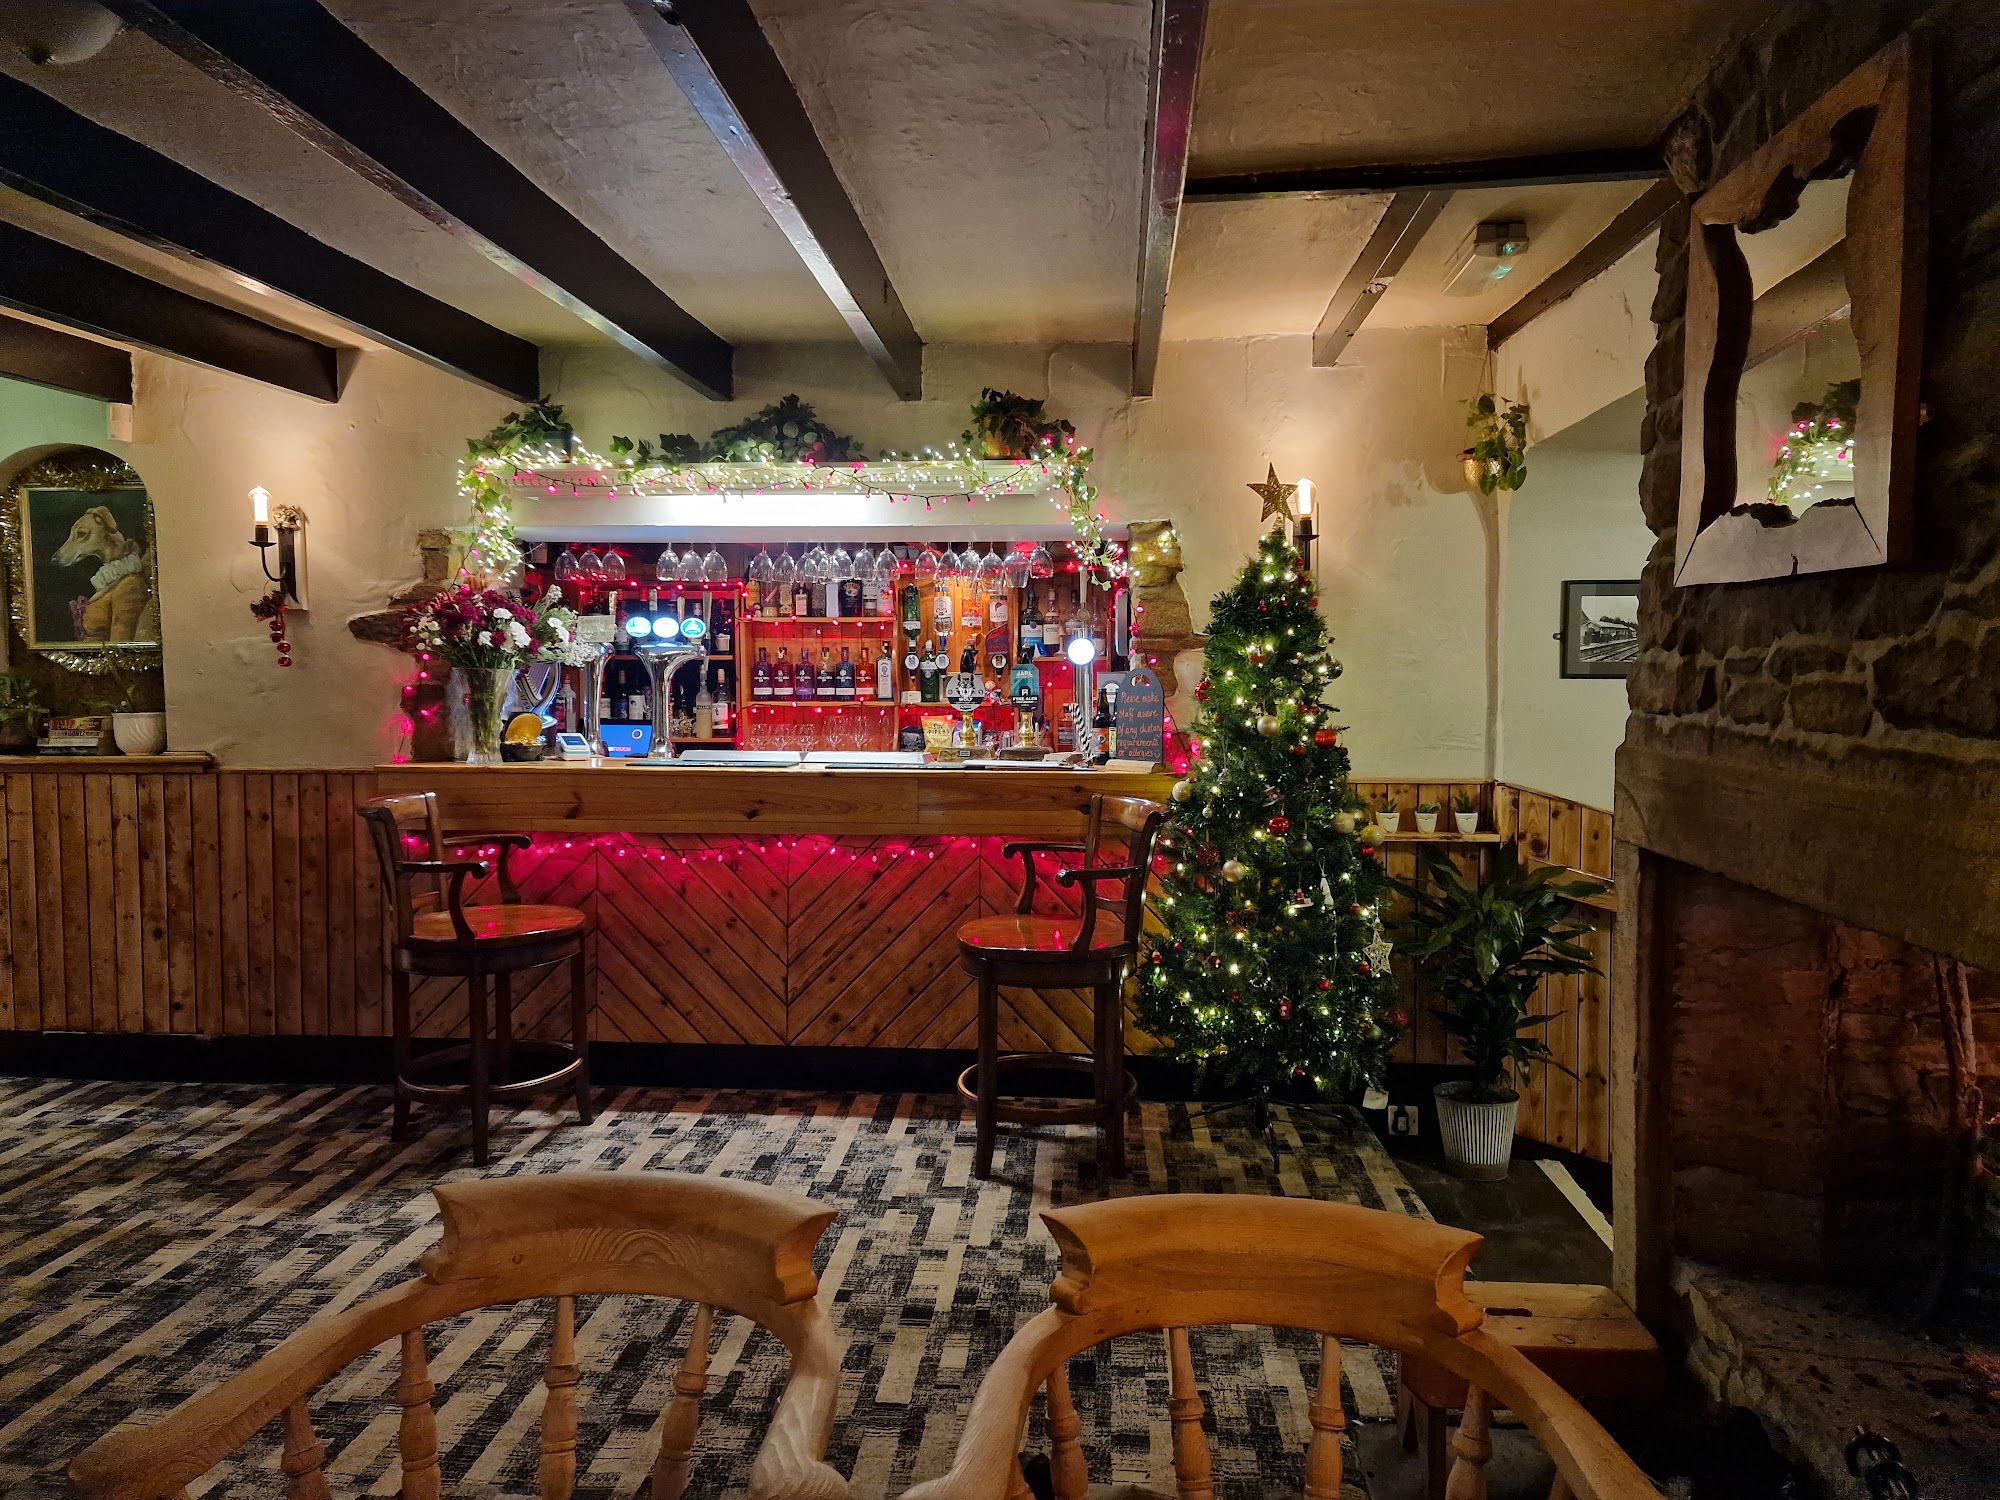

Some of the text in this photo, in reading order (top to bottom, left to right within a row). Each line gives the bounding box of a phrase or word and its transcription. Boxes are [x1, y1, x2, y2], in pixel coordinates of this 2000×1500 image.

[1121, 691, 1160, 704] Please make
[1118, 707, 1159, 722] staff aware
[1125, 726, 1137, 740] any
[1140, 723, 1163, 738] dietary
[1117, 738, 1159, 749] requirements
[1118, 748, 1154, 760] or allergies
